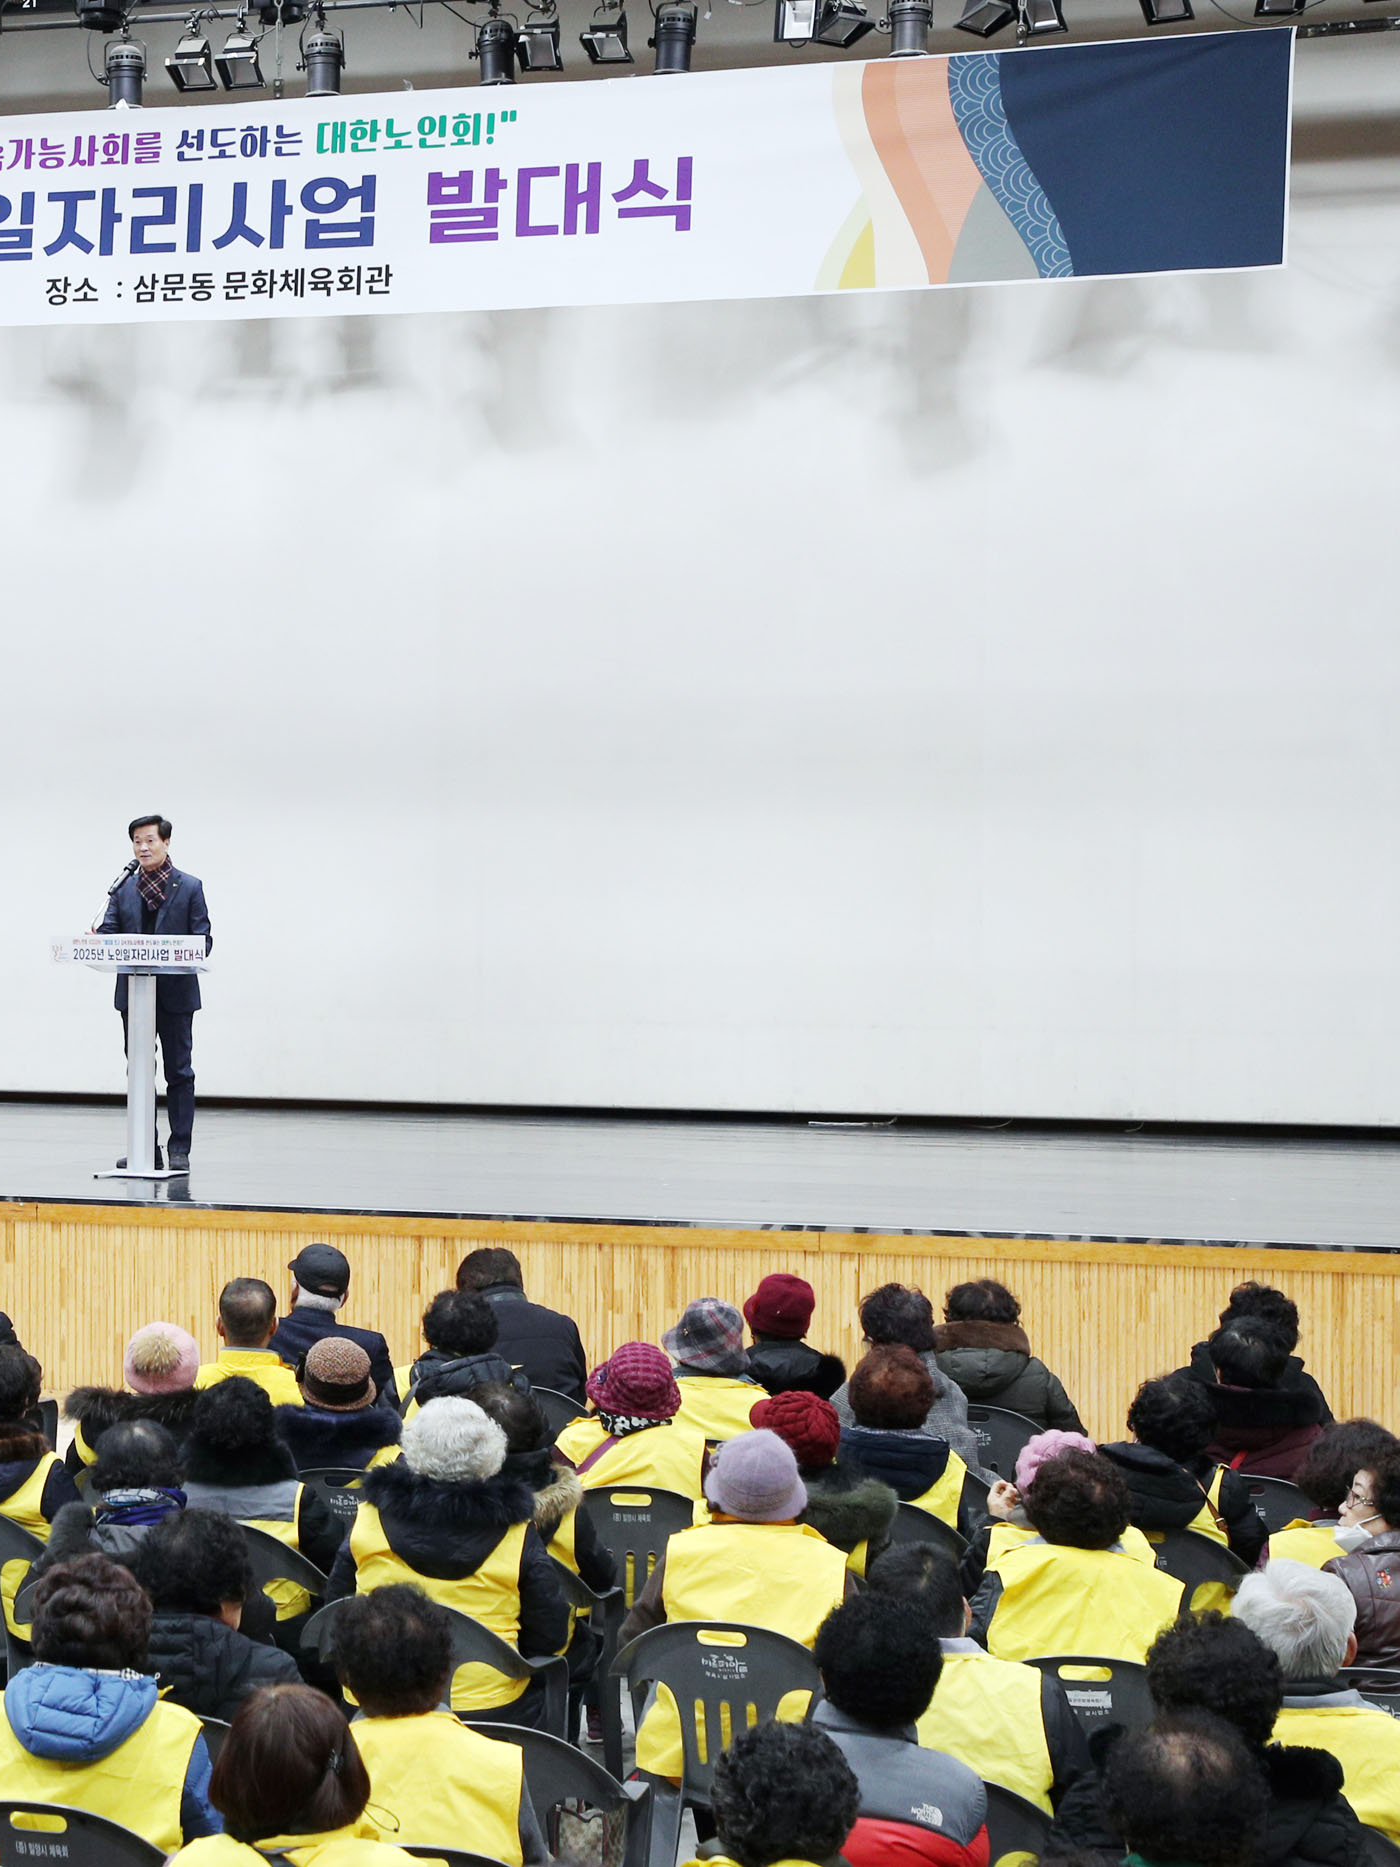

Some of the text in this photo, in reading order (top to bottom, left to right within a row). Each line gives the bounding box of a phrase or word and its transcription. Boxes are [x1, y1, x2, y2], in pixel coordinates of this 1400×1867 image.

[176, 125, 303, 162] 선도하는
[316, 110, 517, 154] 대한노인회!"
[427, 156, 693, 244] 발대식
[46, 276, 98, 306] 장소
[134, 273, 215, 303] 삼문동
[223, 264, 393, 300] 문화체육회관
[73, 949, 104, 960] 2025년
[108, 949, 169, 960] 노인일자리사업
[174, 949, 203, 961] 발대식
